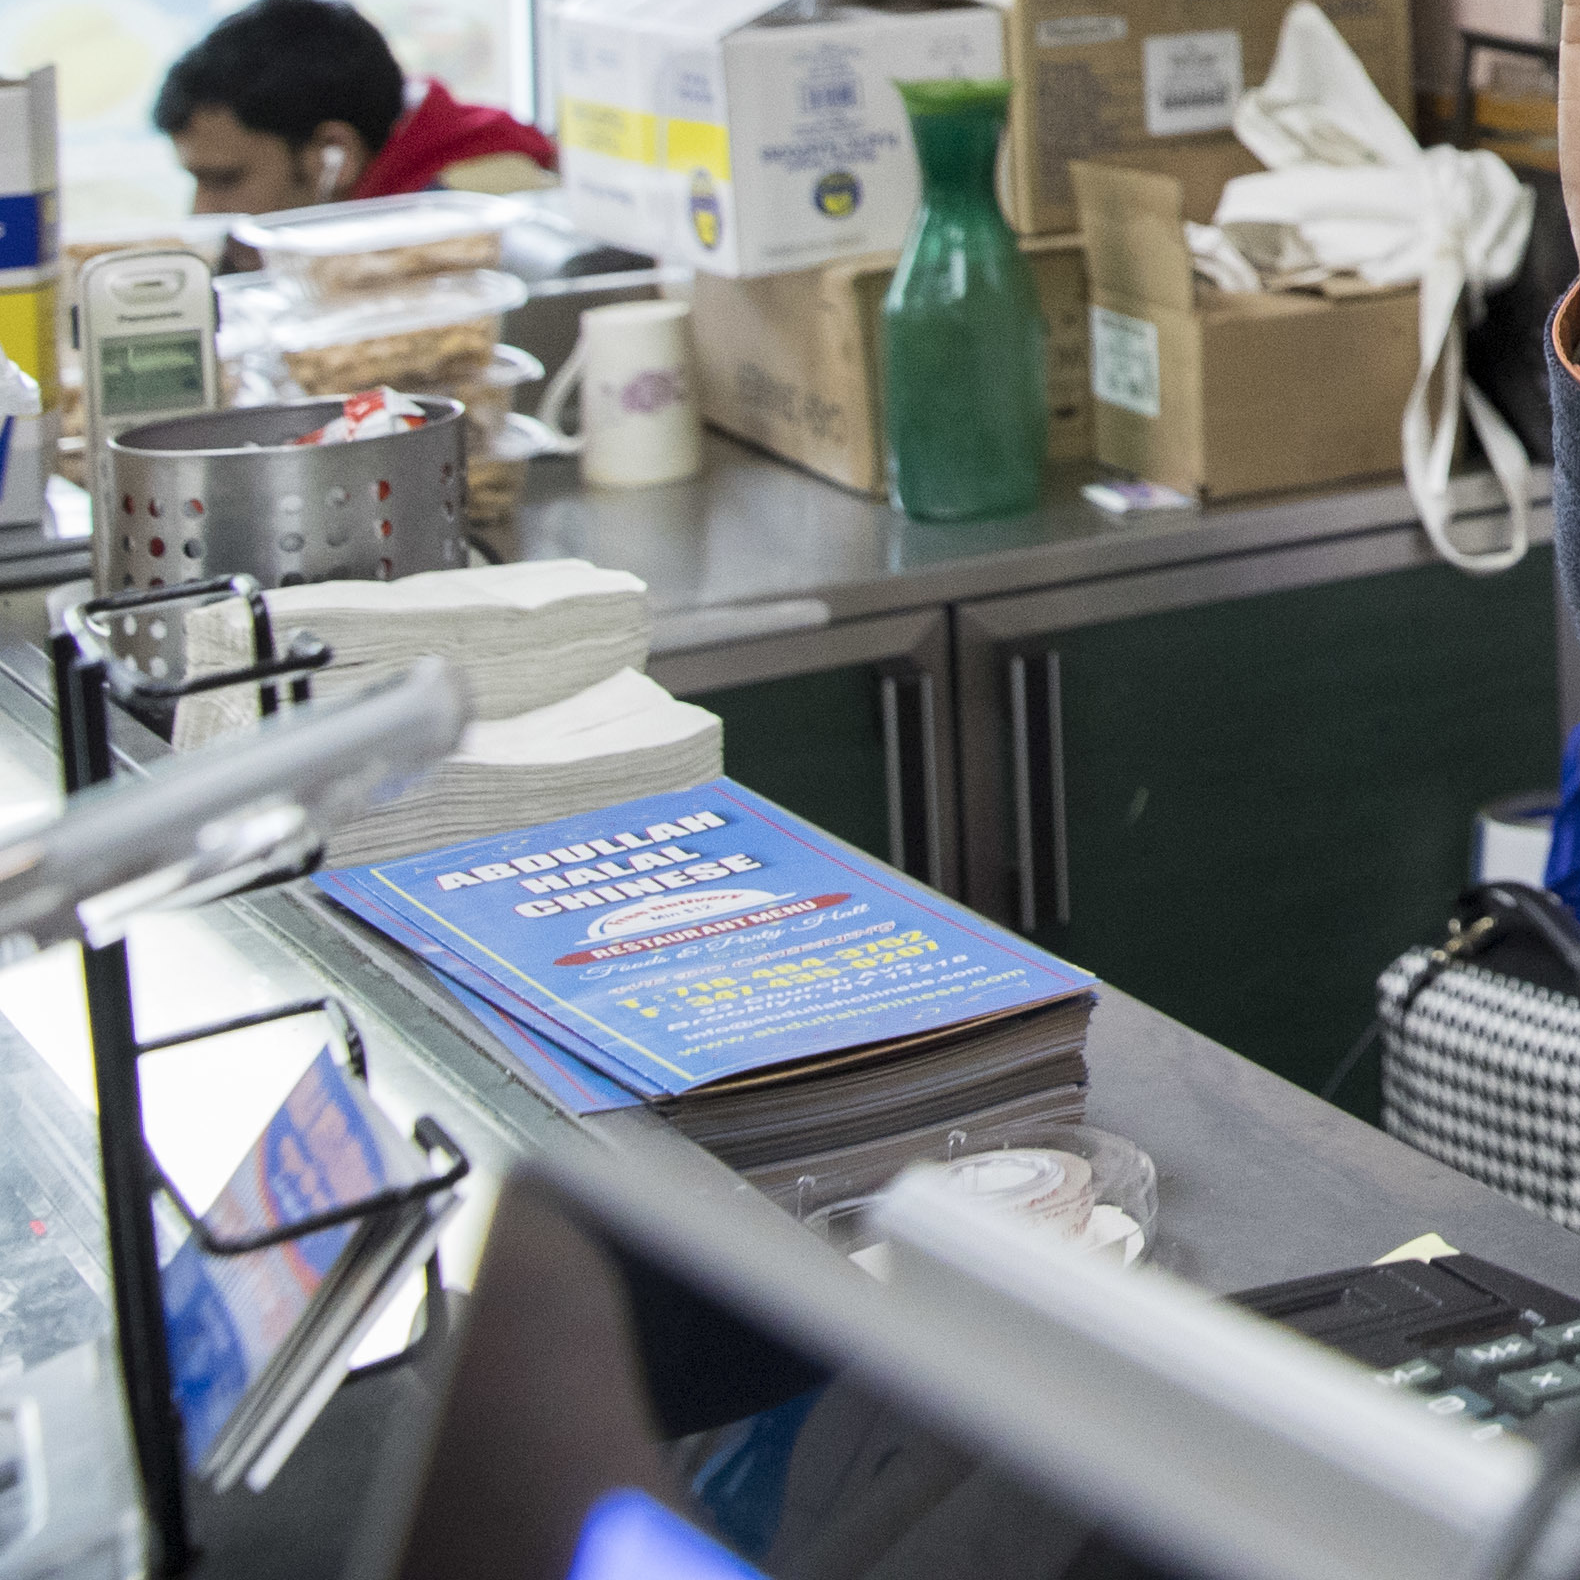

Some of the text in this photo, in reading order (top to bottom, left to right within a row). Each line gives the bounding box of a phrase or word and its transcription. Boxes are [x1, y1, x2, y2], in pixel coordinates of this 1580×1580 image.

[435, 810, 727, 891] ABDULLAH
[519, 844, 702, 895] HALAL
[513, 852, 764, 919] CHINESE
[648, 892, 746, 914] Delivery
[590, 916, 749, 961] RESTAURANT
[749, 899, 819, 925] MENU
[649, 910, 679, 922] Min
[676, 946, 702, 960] &
[703, 926, 786, 952] Party
[791, 903, 871, 933] Hall
[743, 976, 851, 1006] Church
[831, 976, 876, 995] NY
